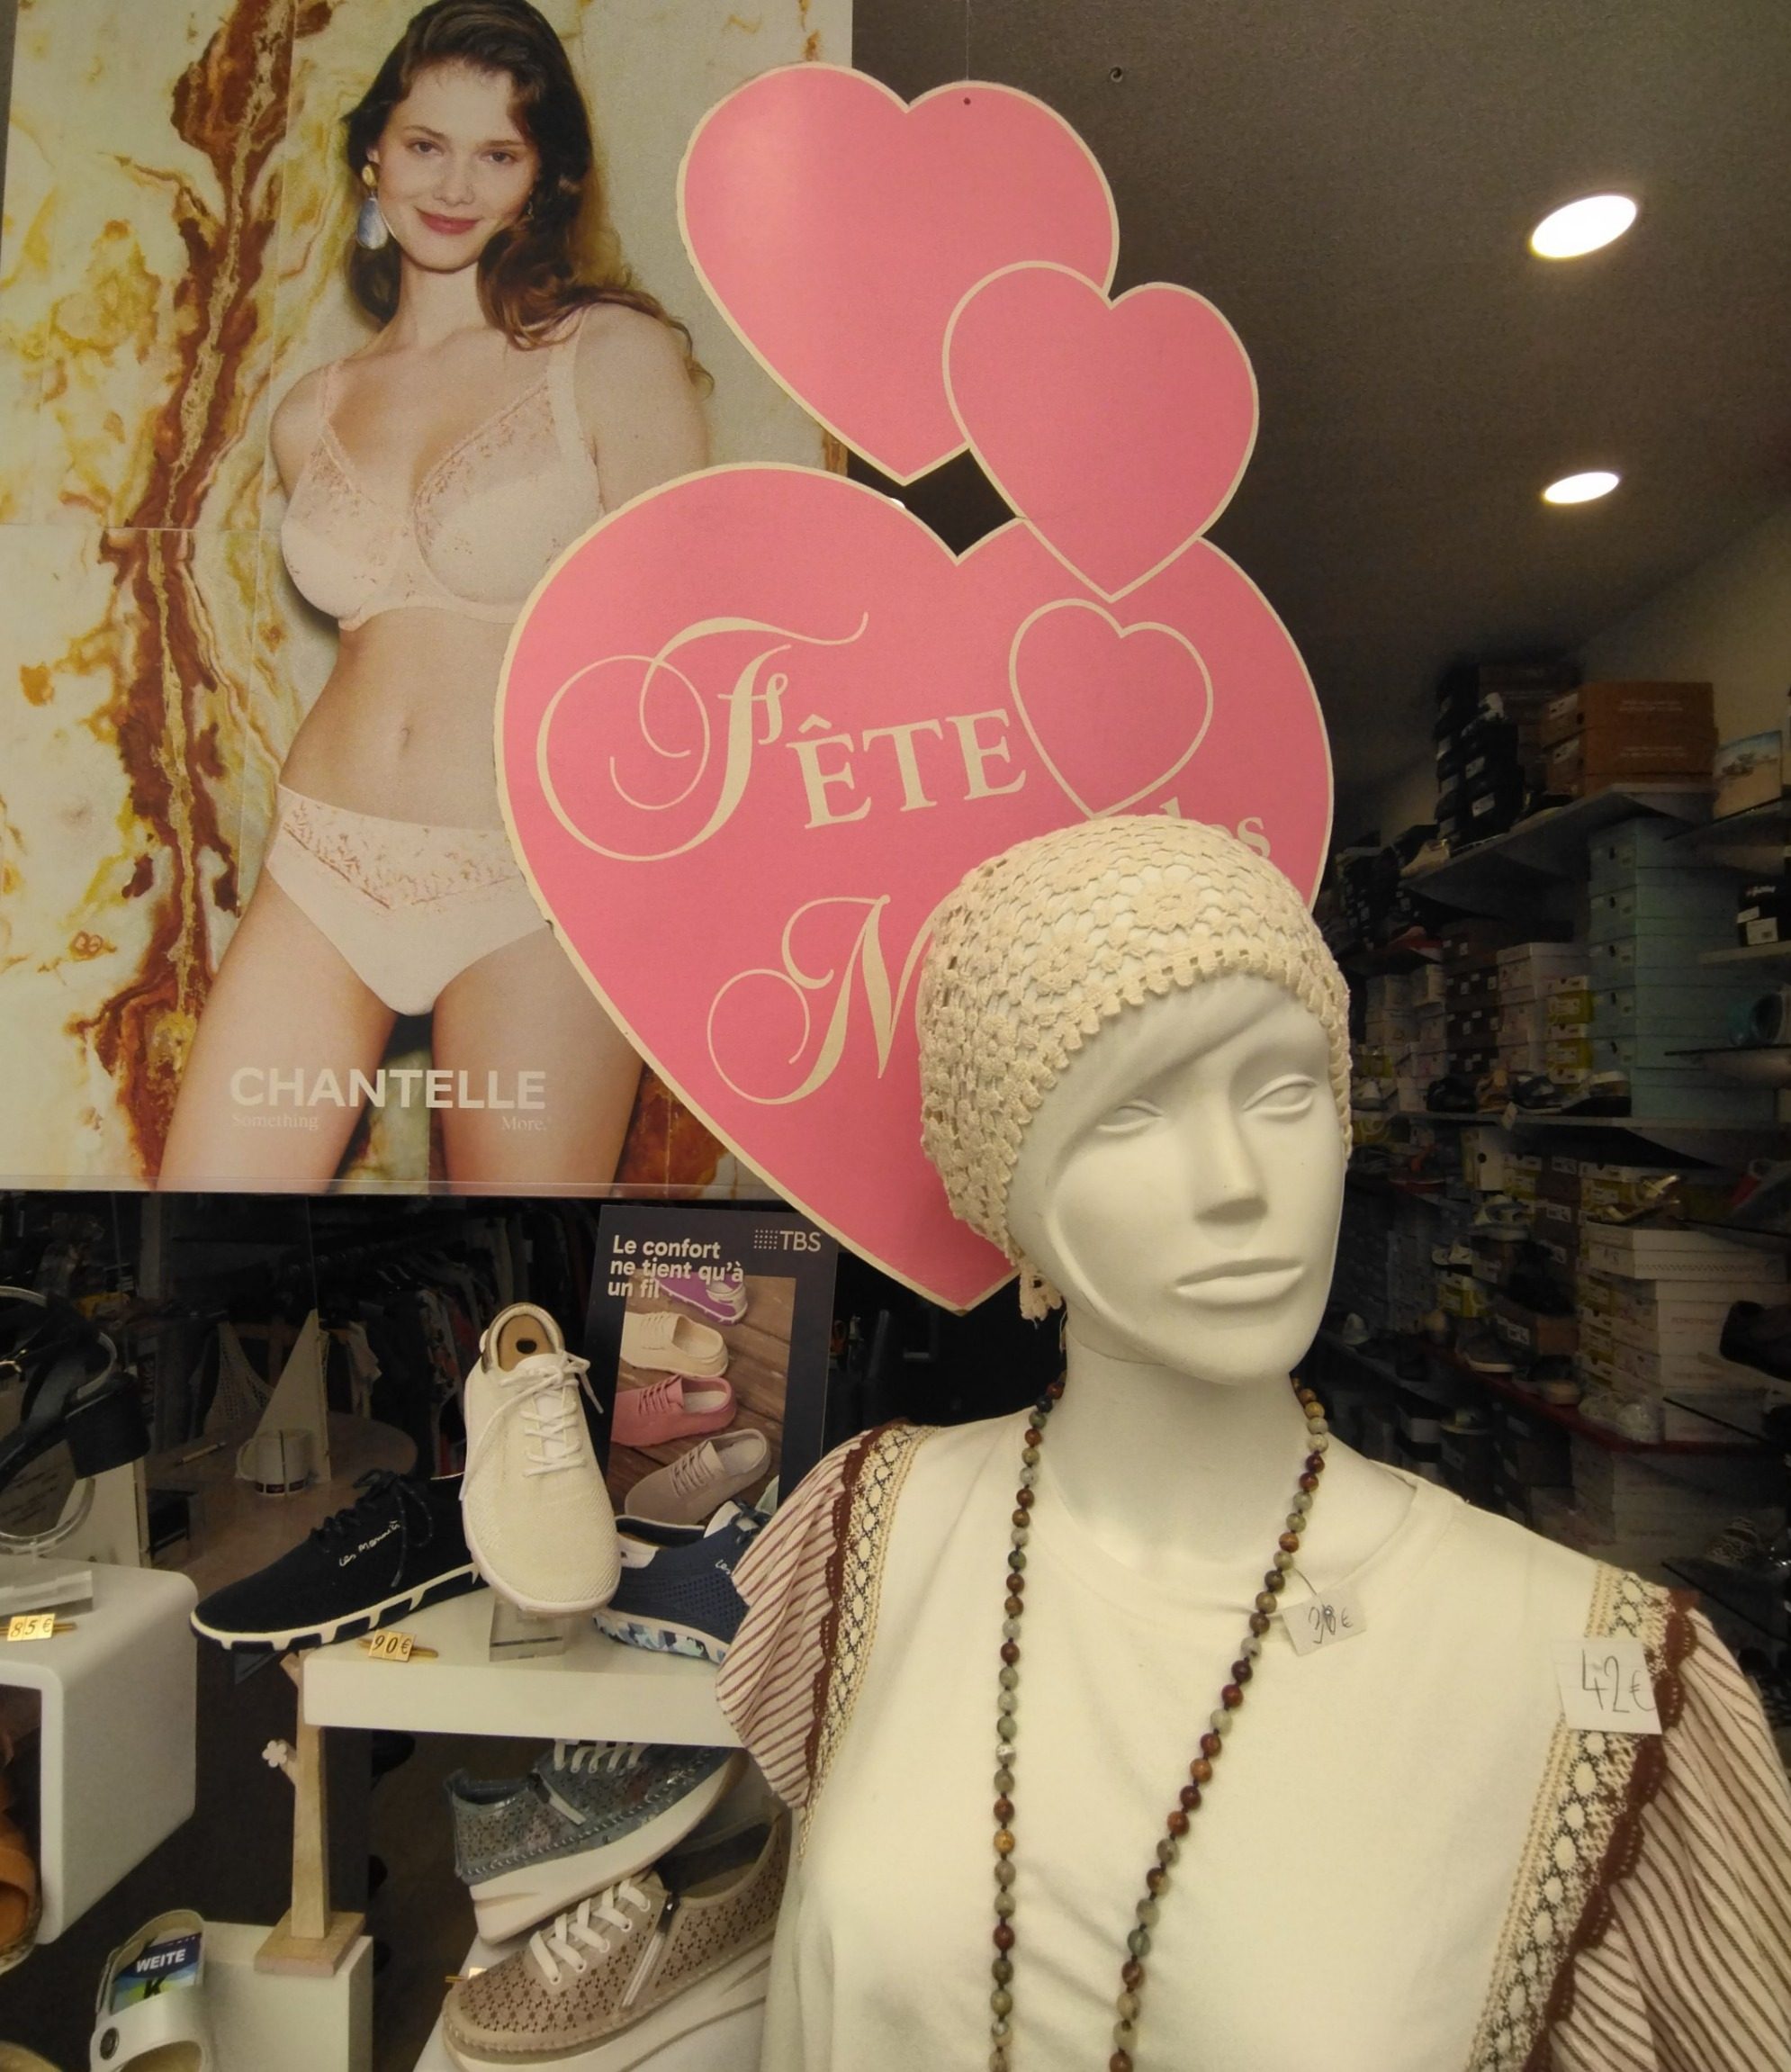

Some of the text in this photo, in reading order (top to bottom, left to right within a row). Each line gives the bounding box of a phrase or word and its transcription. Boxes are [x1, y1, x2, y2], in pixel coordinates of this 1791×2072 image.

[537, 612, 1028, 861] FÊTE
[230, 1068, 546, 1110] CHANTELLE
[230, 1113, 319, 1131] Something
[613, 1235, 721, 1259] Le confort
[779, 1230, 822, 1252] TBS
[609, 1260, 636, 1275] ne
[642, 1257, 693, 1279] tient
[608, 1278, 661, 1299] un fil
[136, 1949, 186, 1973] WEITE
